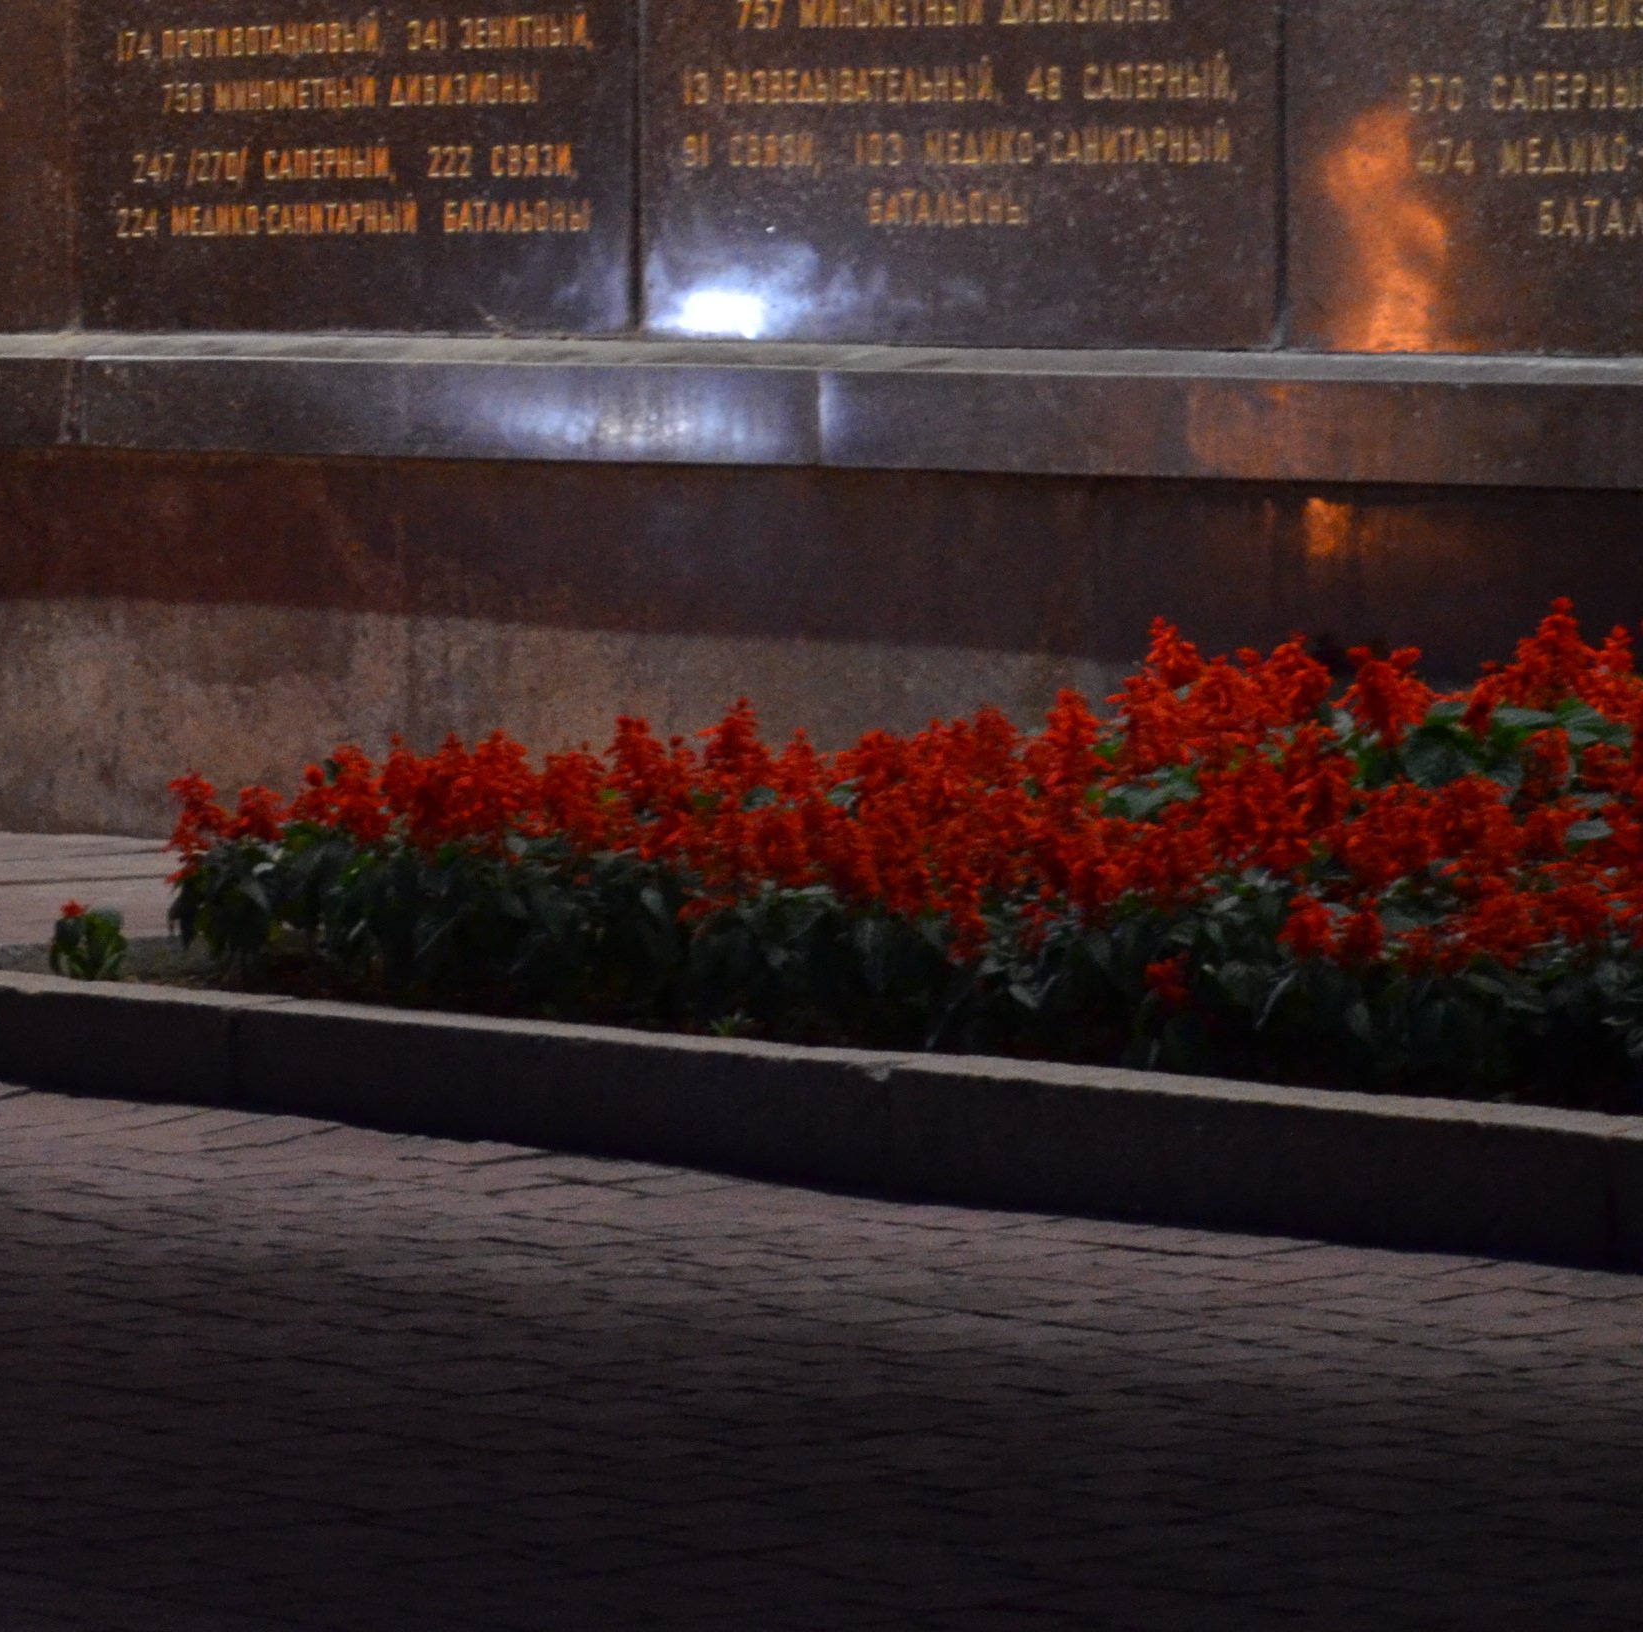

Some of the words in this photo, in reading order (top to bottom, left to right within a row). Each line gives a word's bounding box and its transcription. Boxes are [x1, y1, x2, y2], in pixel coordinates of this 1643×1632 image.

[390, 70, 541, 107] ДИВИЗИОНЫ
[924, 118, 1233, 166] МЕДИКО-САНИТАРНЫЙ
[427, 146, 473, 179] 222
[443, 199, 592, 235] БАТАЛЬОНЫ
